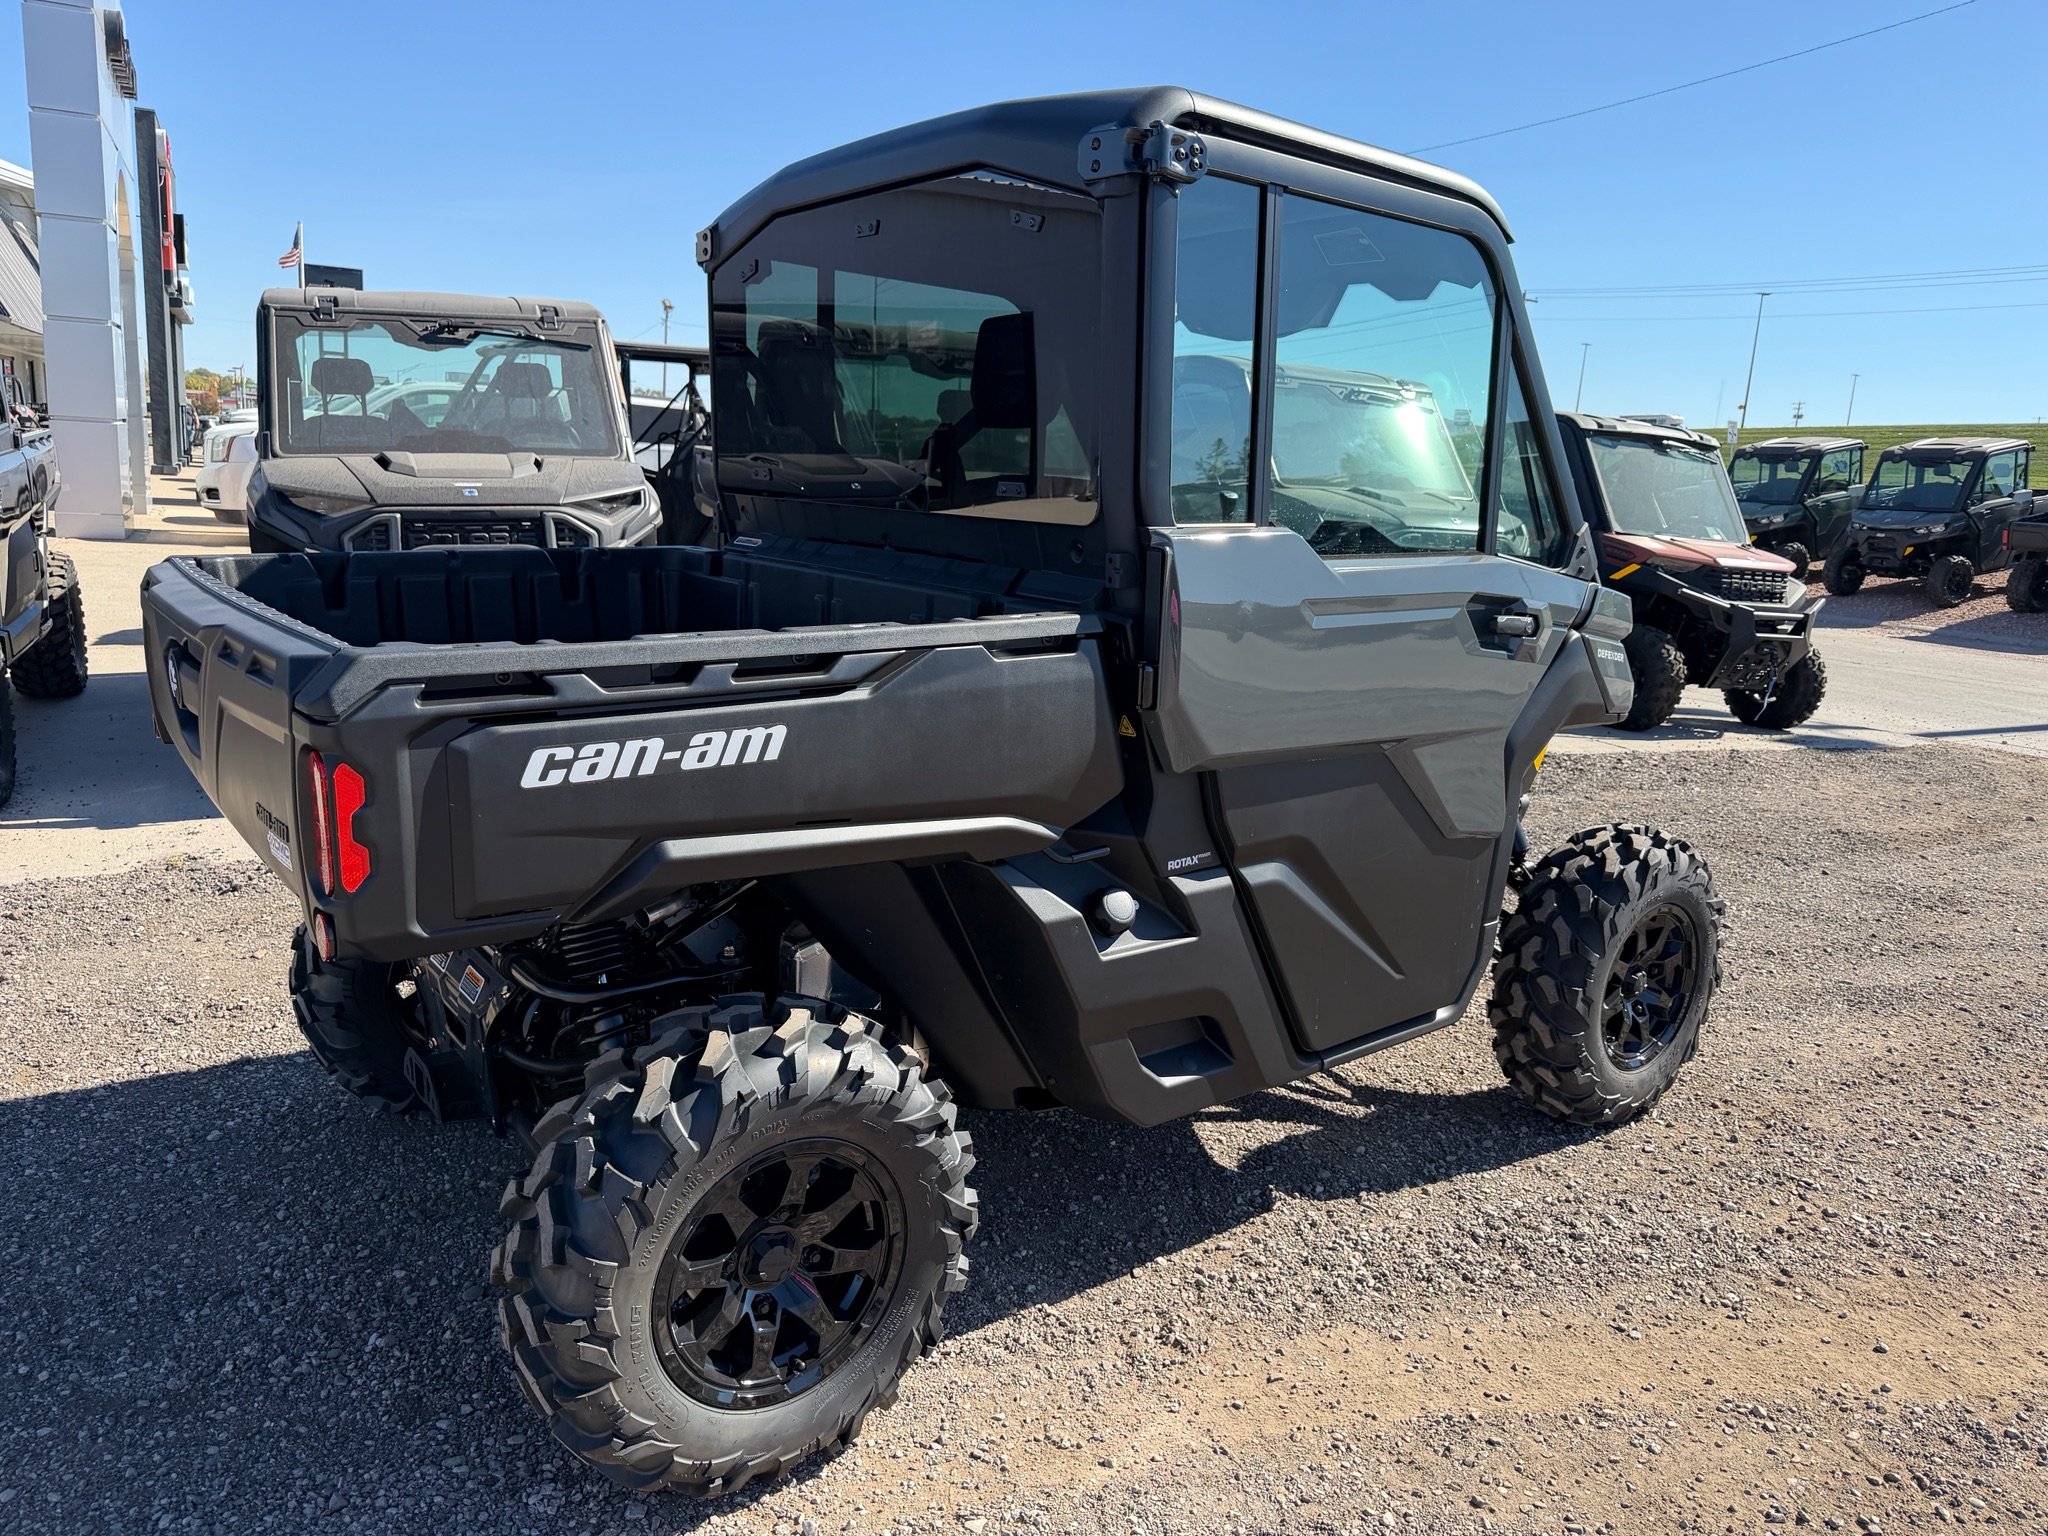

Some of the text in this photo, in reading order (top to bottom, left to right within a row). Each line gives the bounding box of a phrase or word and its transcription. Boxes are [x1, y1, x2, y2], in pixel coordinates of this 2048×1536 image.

[1597, 648, 1625, 663] DEFENDER
[520, 724, 788, 789] can-am
[1168, 855, 1198, 870] ROTAX
